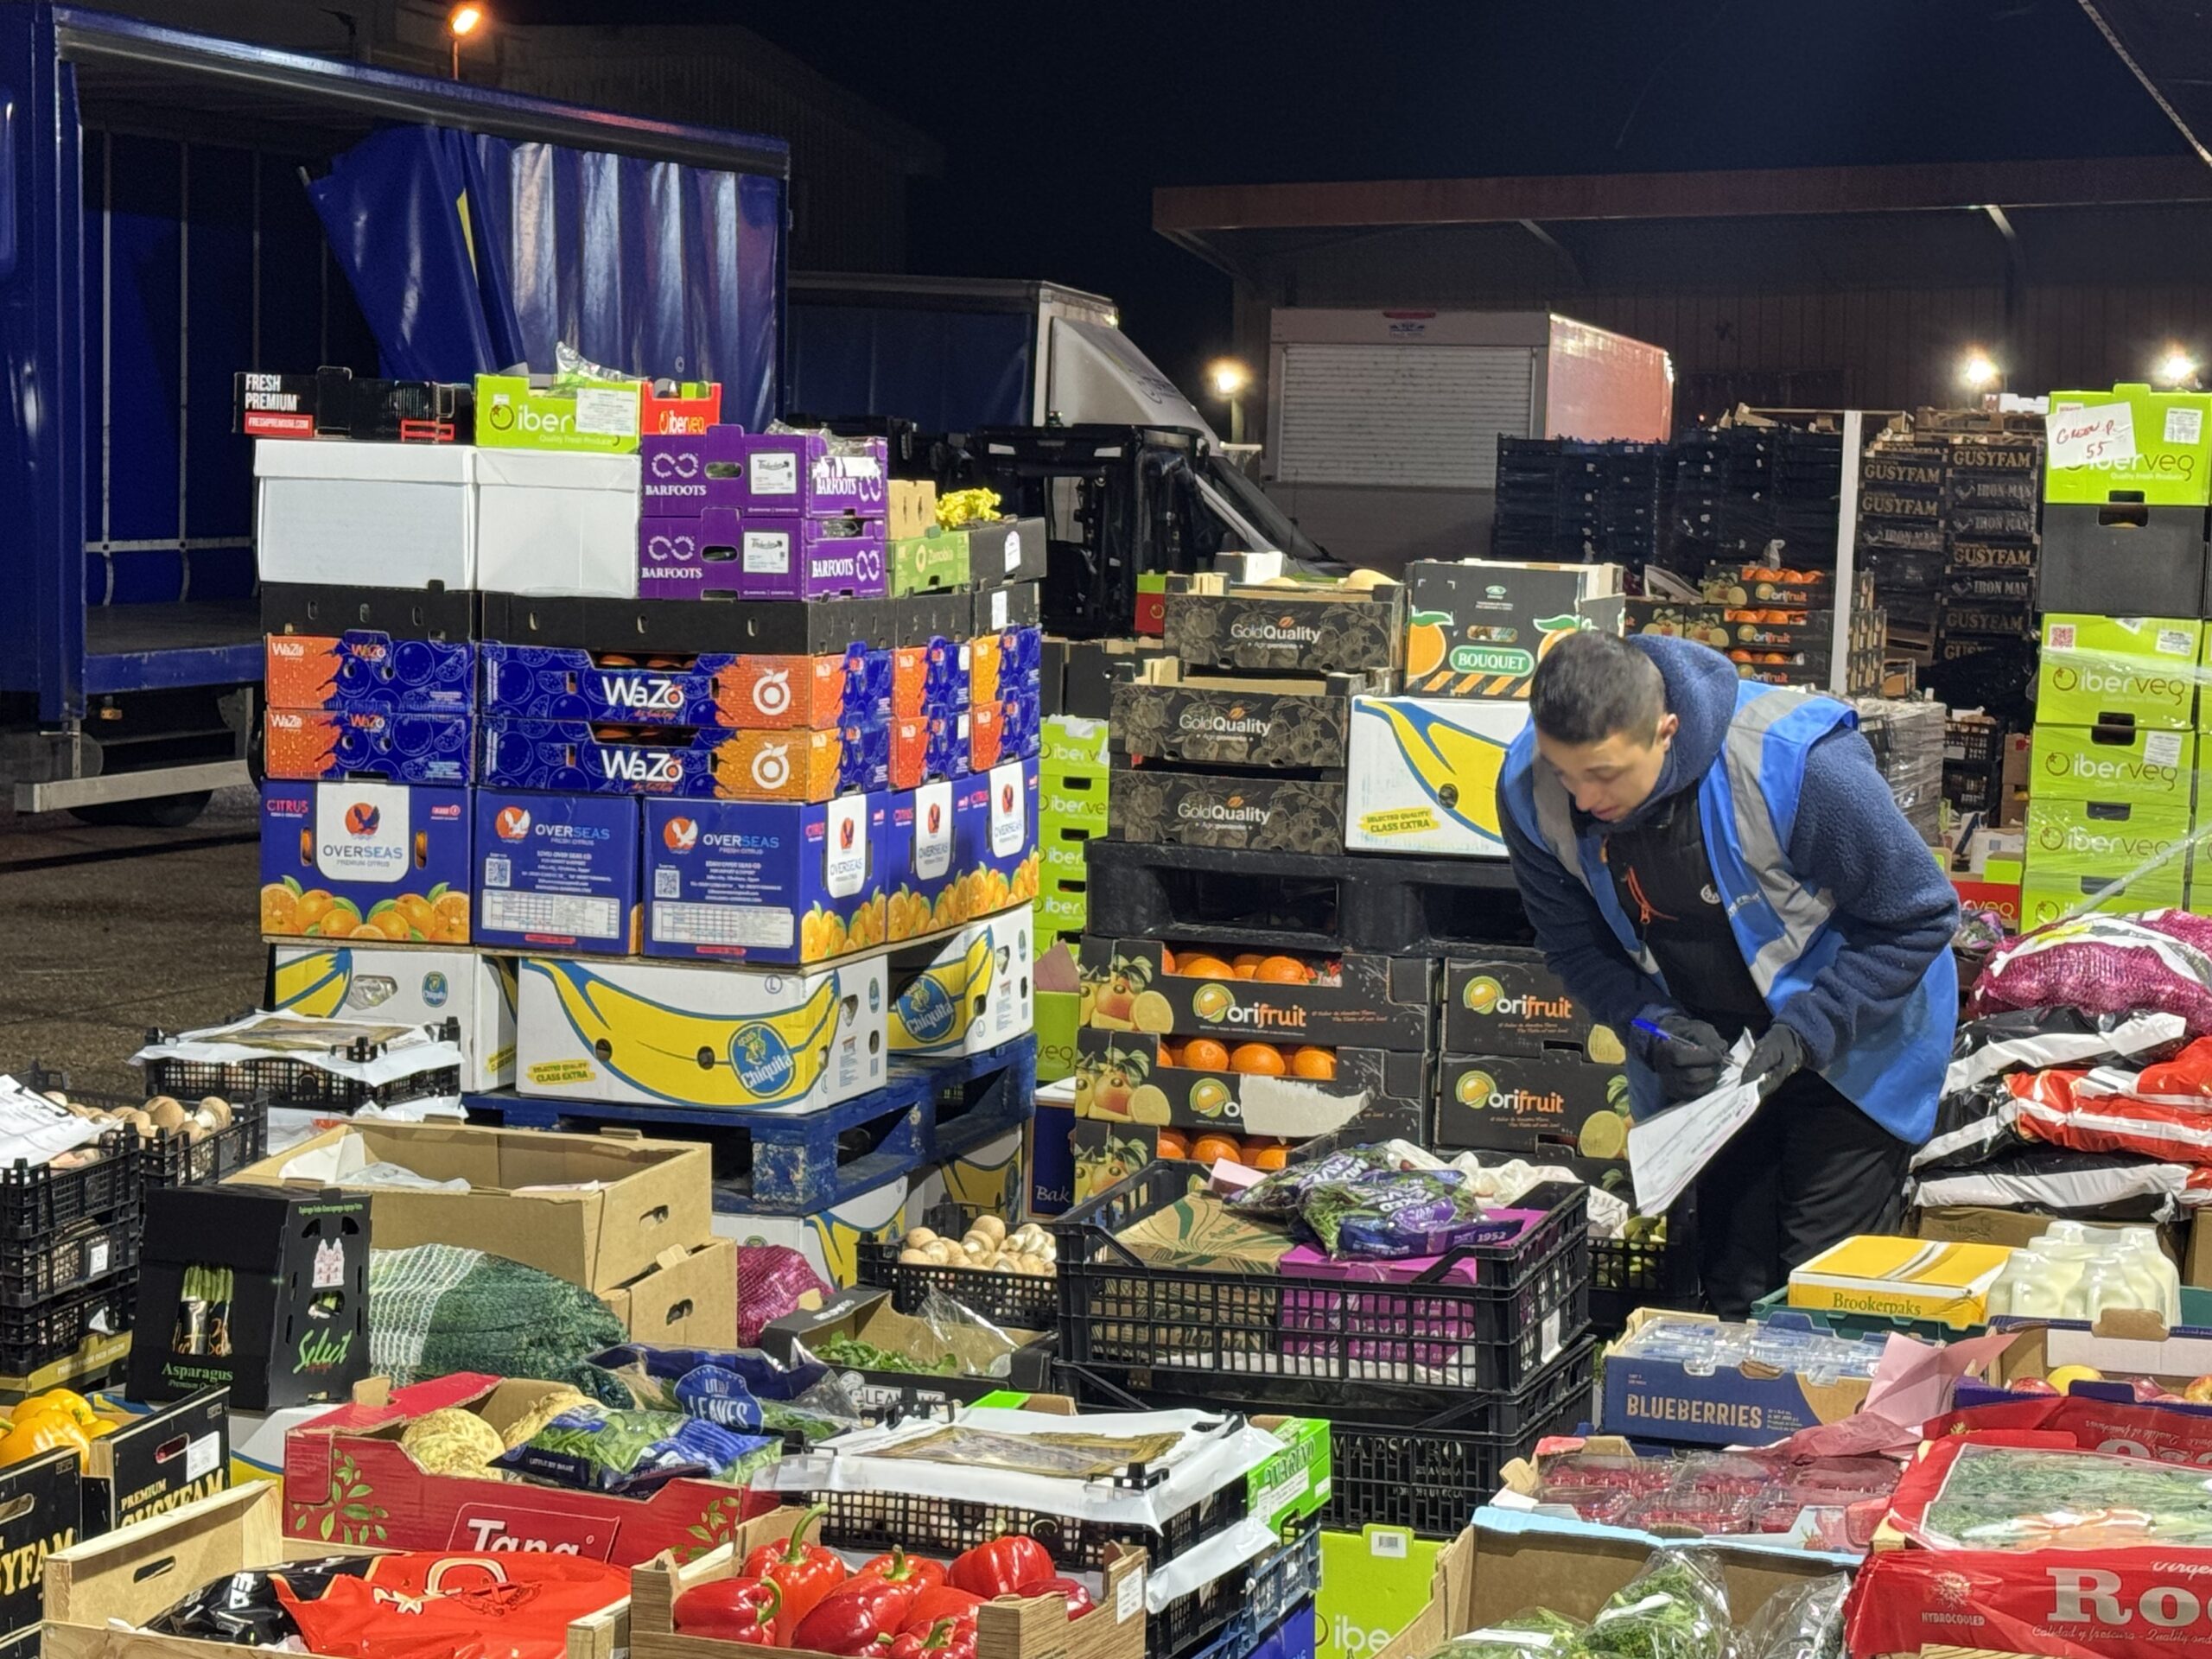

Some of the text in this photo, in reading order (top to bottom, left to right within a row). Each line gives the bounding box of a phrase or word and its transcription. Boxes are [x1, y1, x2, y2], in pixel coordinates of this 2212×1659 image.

[245, 374, 282, 392] FRESH
[245, 392, 298, 412] PREMIUM
[1953, 449, 2031, 468] GUSYFAM
[1864, 464, 1940, 483] GUSYFAM
[645, 484, 707, 497] BARFOOTS
[816, 477, 856, 495] BARFOOTS
[1862, 496, 1939, 517] GUSYFAM
[1953, 548, 2031, 565] GUSYFAM
[641, 567, 702, 579] BARFOOTS
[811, 558, 854, 578] BARFOOTS
[1974, 580, 2029, 597] IRON MAN
[1947, 613, 2024, 632] GUSYFAM
[1230, 623, 1322, 645] GoldQuality
[1458, 652, 1527, 671] BOUQUET
[601, 676, 683, 709] WaZo
[2080, 666, 2185, 706] iberveg
[1179, 714, 1272, 736] GoldQuality
[1053, 743, 1098, 762] iberv
[601, 748, 683, 784] WaZo
[2073, 753, 2178, 791] iberveg
[266, 799, 308, 813] CITRUS
[1050, 794, 1106, 815] iberve
[1177, 803, 1271, 825] GoldQuality
[535, 823, 611, 840] OVERSEAS
[1370, 819, 1430, 833] CLASS EXTRA
[702, 834, 780, 849] OVERSEAS
[918, 842, 949, 859] OVERSEAS
[323, 844, 403, 860] OVERSEAS
[1048, 846, 1084, 864] iber
[830, 858, 863, 876] OVERSEAS
[1227, 1002, 1307, 1029] orifruit
[1497, 995, 1573, 1020] orifruit
[906, 1001, 954, 1037] Chiquita
[536, 1071, 588, 1083] CLASS EXTRA
[741, 1051, 794, 1092] Chiquita
[1488, 1089, 1565, 1115] orifruit
[1477, 1231, 1507, 1243] 1952
[1833, 1292, 1922, 1316] Brookerpaks
[162, 1362, 234, 1383] Asparagus
[1626, 1393, 1763, 1430] BLUEBERRIES
[121, 1478, 167, 1511] PREMIUM
[2046, 1567, 2212, 1627] Ro
[1921, 1611, 1986, 1627] HYDROCOOLED
[2031, 1625, 2075, 1638] Calidad
[2145, 1629, 2189, 1645] Quality
